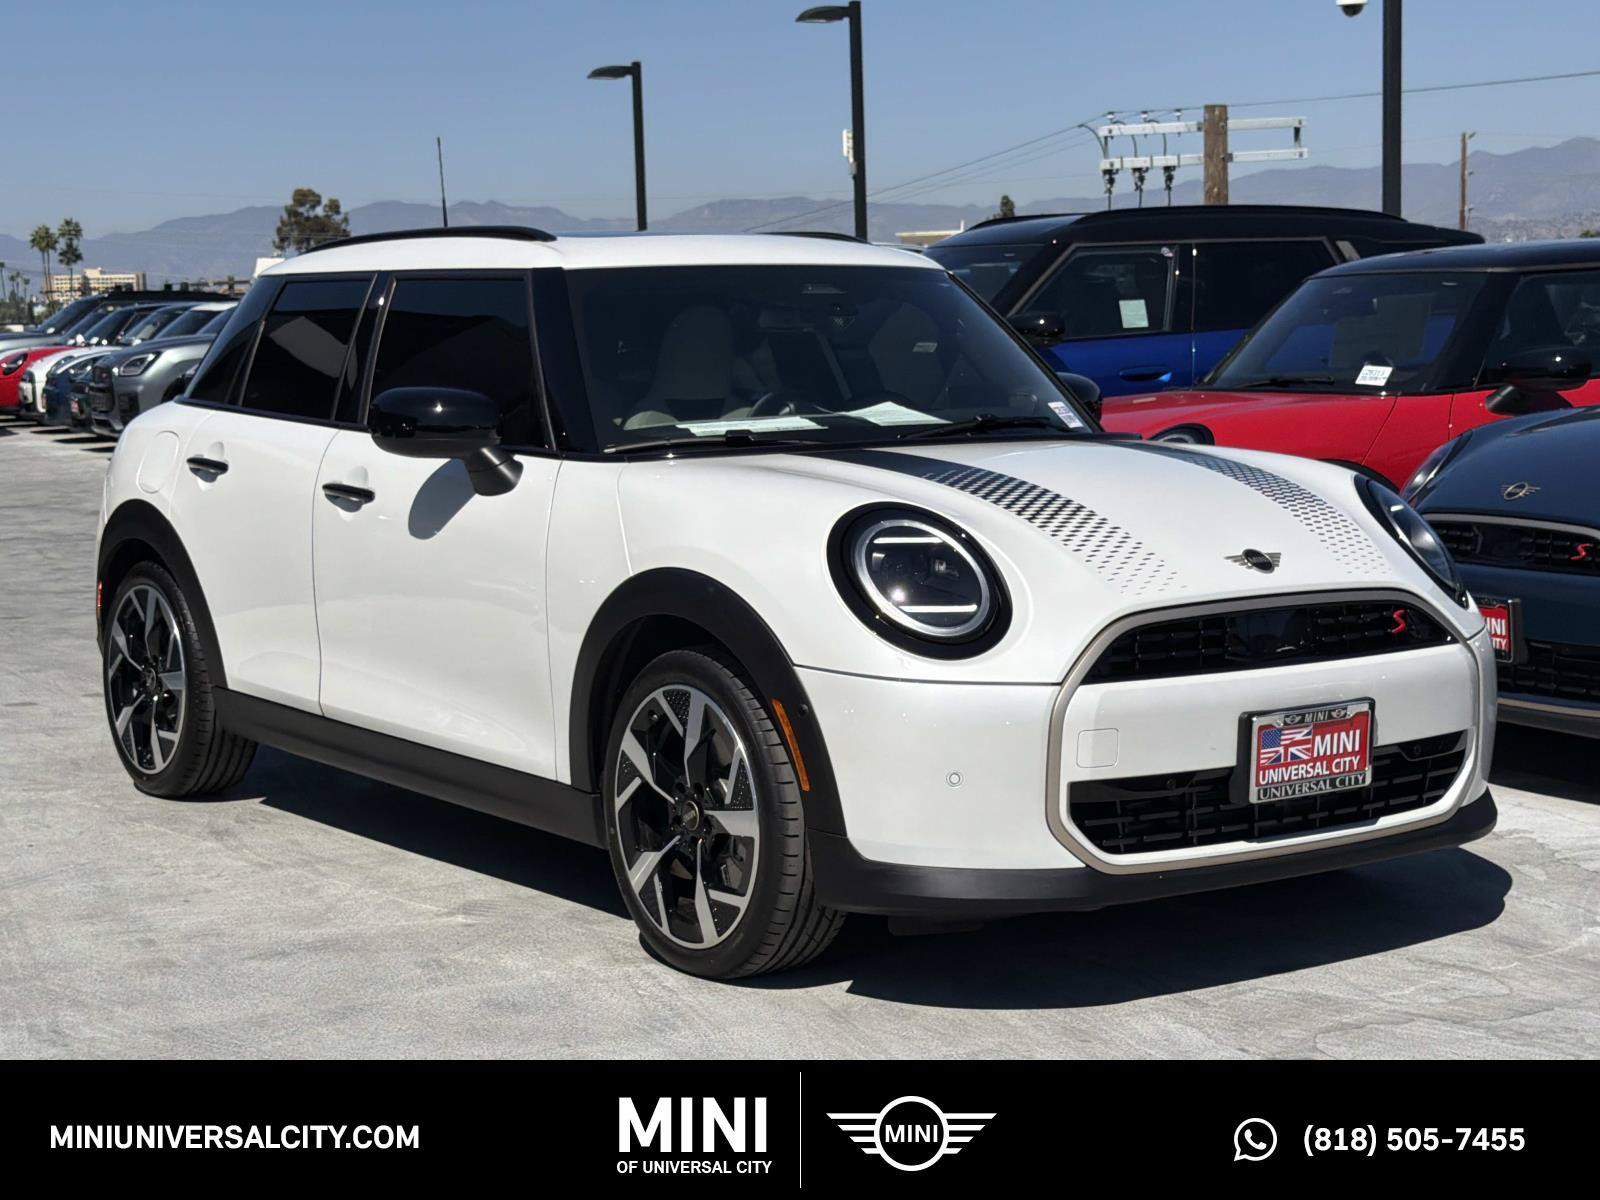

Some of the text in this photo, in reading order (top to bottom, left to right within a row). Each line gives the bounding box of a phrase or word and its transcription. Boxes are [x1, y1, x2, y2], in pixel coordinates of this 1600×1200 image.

[1391, 609, 1407, 634] S
[1485, 616, 1506, 636] INI
[1491, 638, 1507, 650] ITY
[1303, 711, 1329, 723] MINI
[1313, 729, 1361, 758] MINI
[1259, 755, 1361, 785] UNIVERSAL CITY
[1259, 773, 1366, 800] UNIVERSAL CITY
